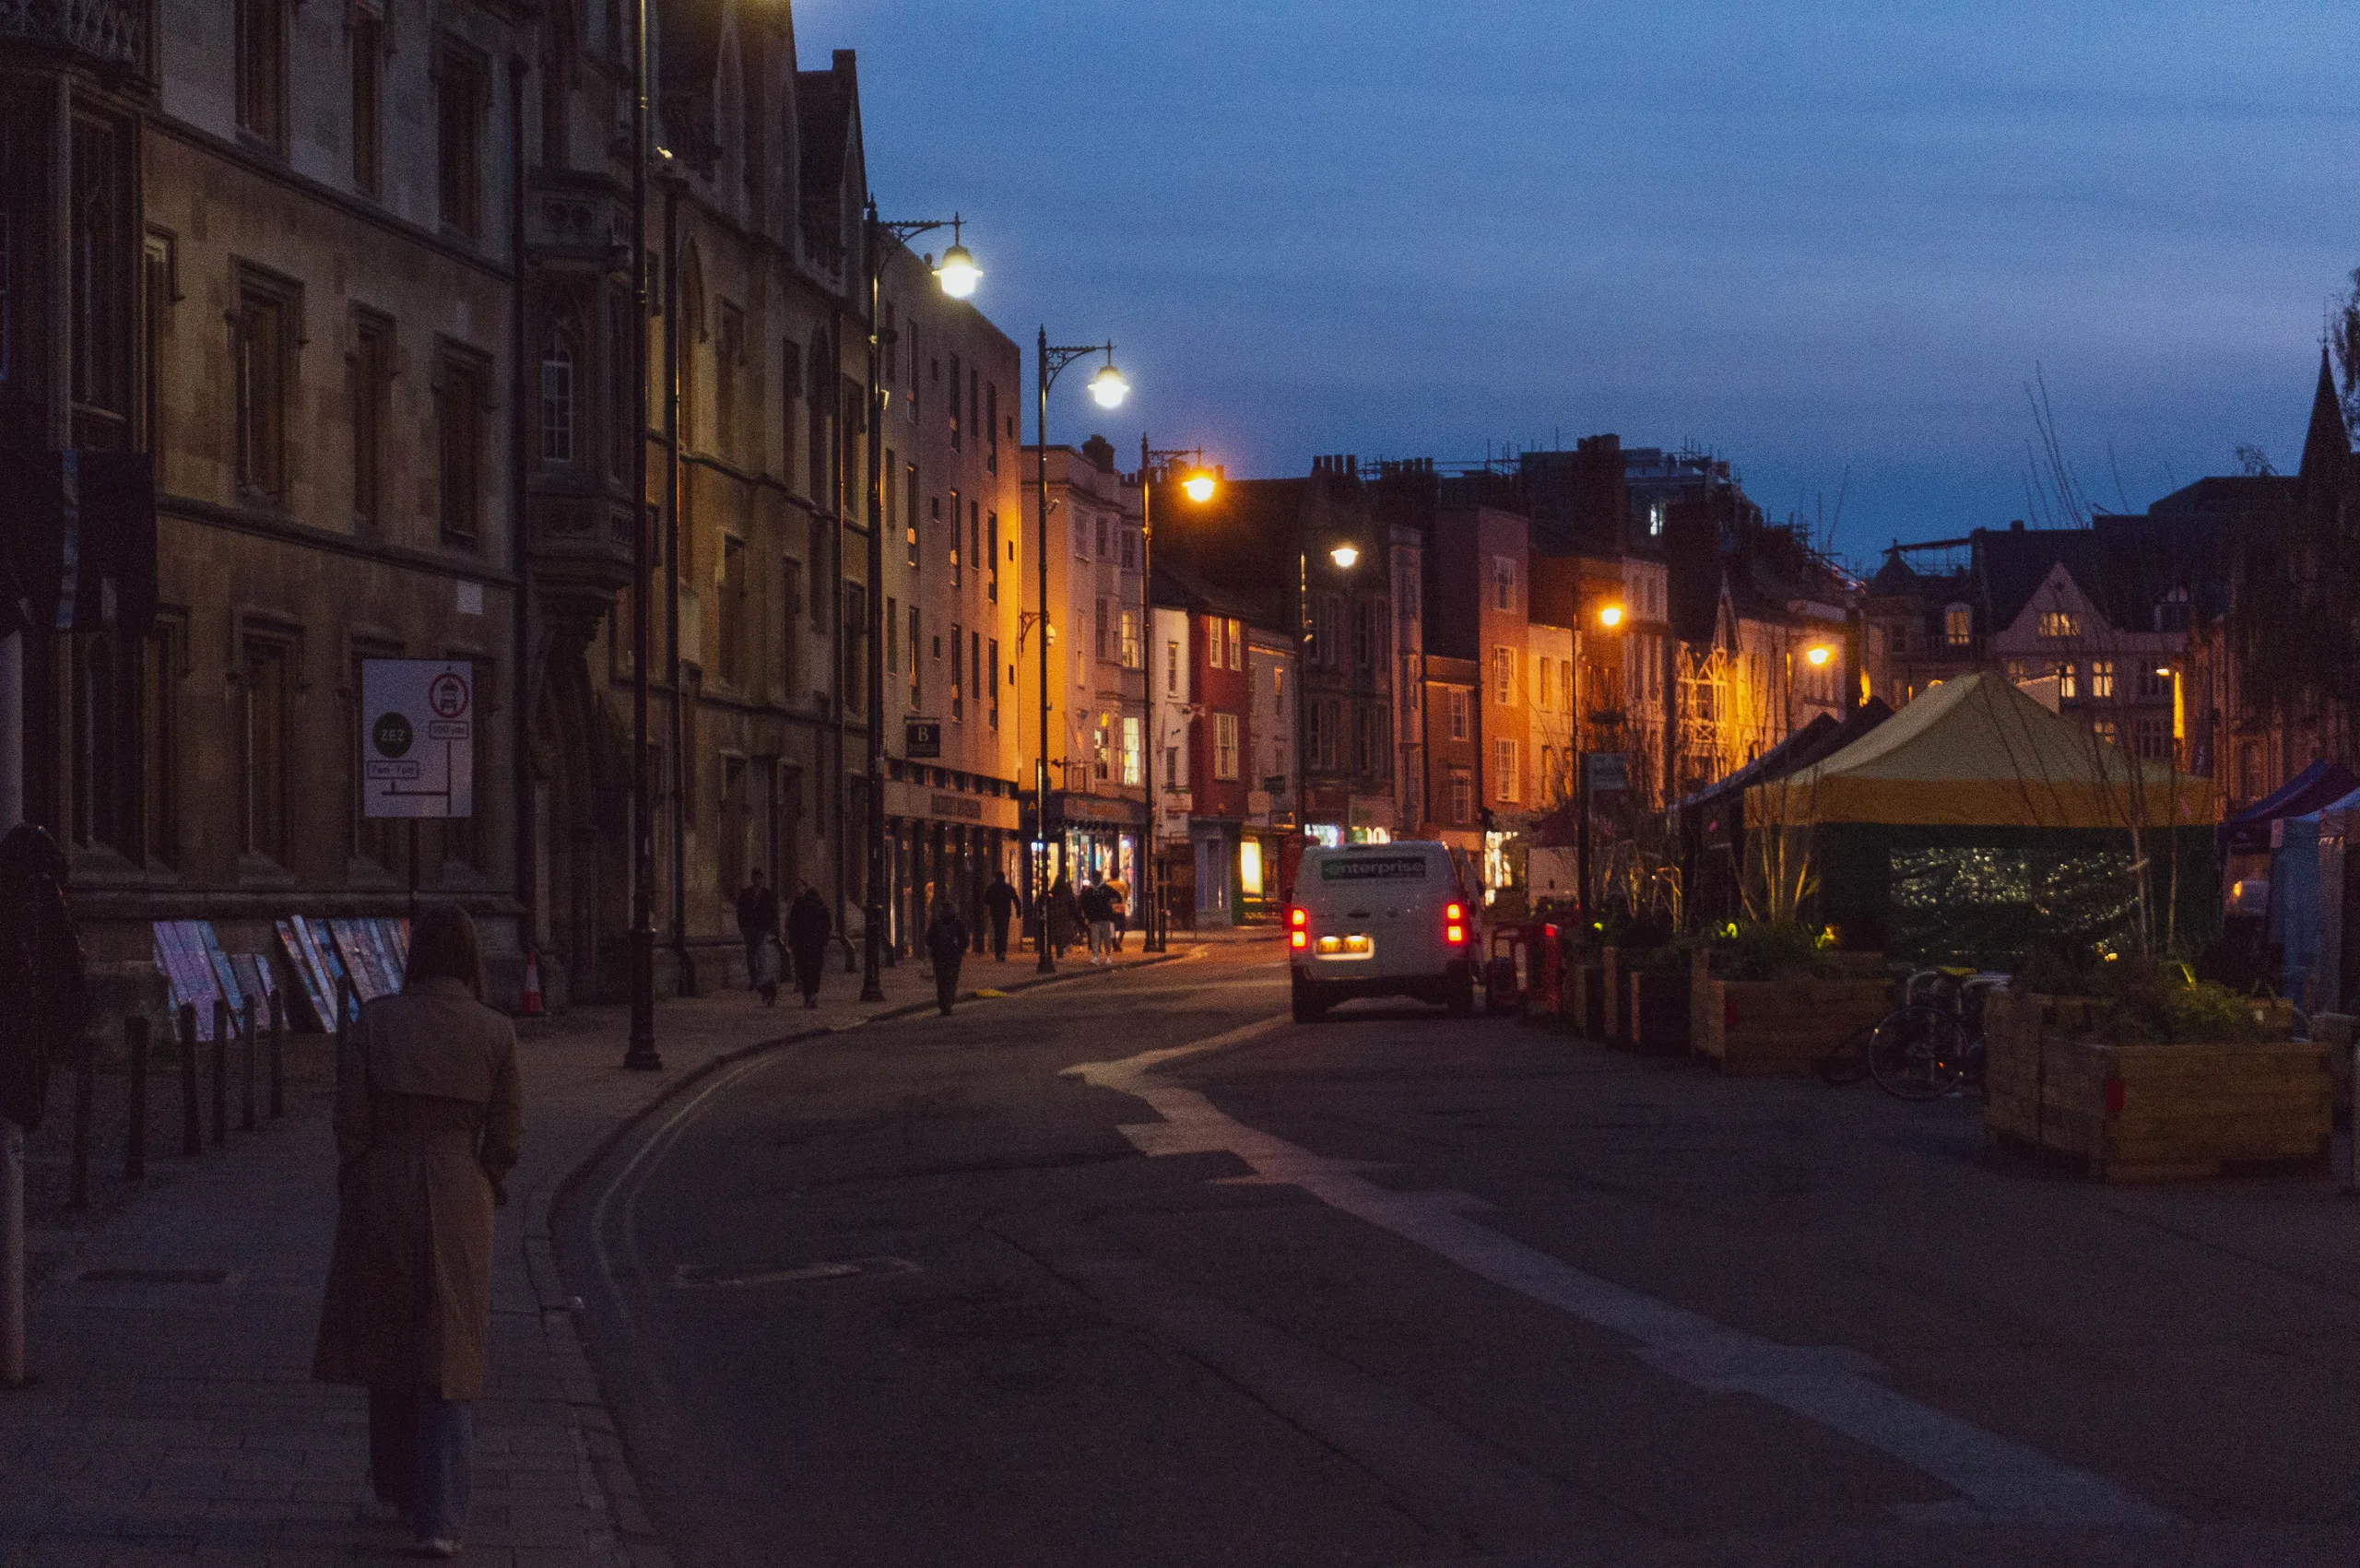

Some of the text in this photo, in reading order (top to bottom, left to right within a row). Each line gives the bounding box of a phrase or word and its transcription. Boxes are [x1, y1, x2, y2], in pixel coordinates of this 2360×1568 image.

[381, 729, 406, 742] ZEZ
[917, 725, 929, 742] B
[1326, 860, 1424, 875] enterprise
